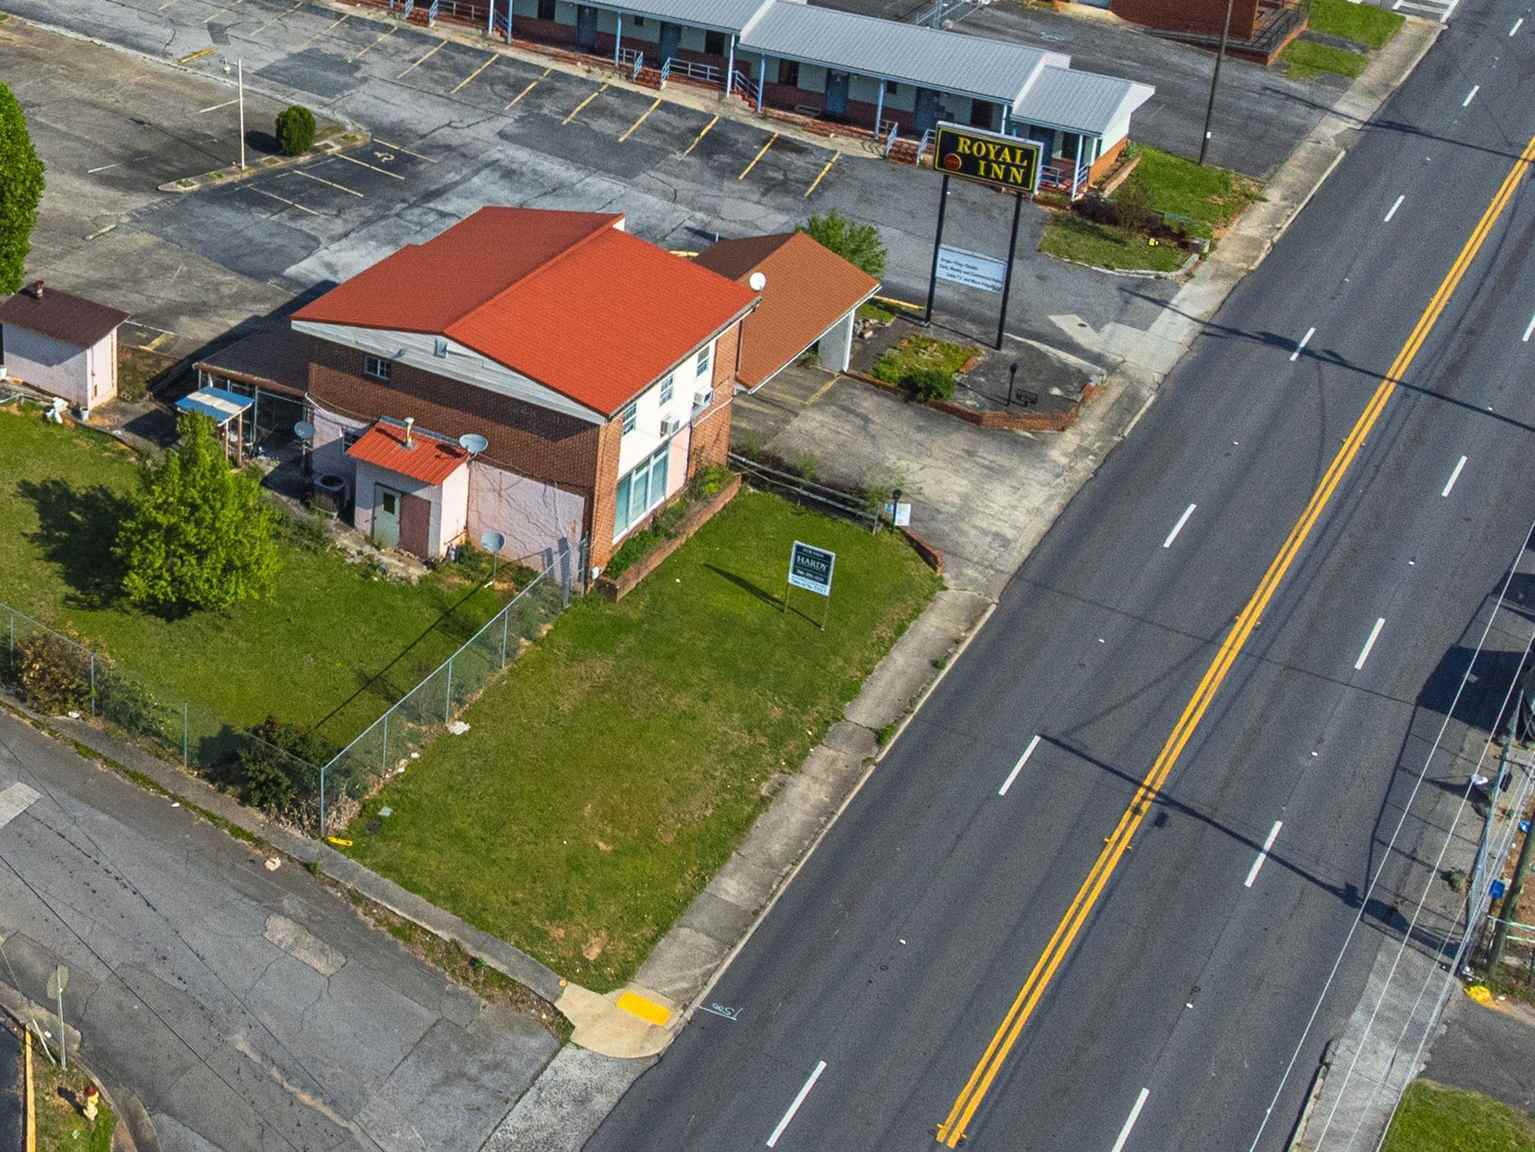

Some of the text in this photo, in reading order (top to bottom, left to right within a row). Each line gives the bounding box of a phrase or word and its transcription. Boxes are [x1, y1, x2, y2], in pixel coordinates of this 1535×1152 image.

[958, 136, 1027, 166] ROYAL
[978, 160, 1024, 184] INN
[797, 555, 828, 571] HARDY
